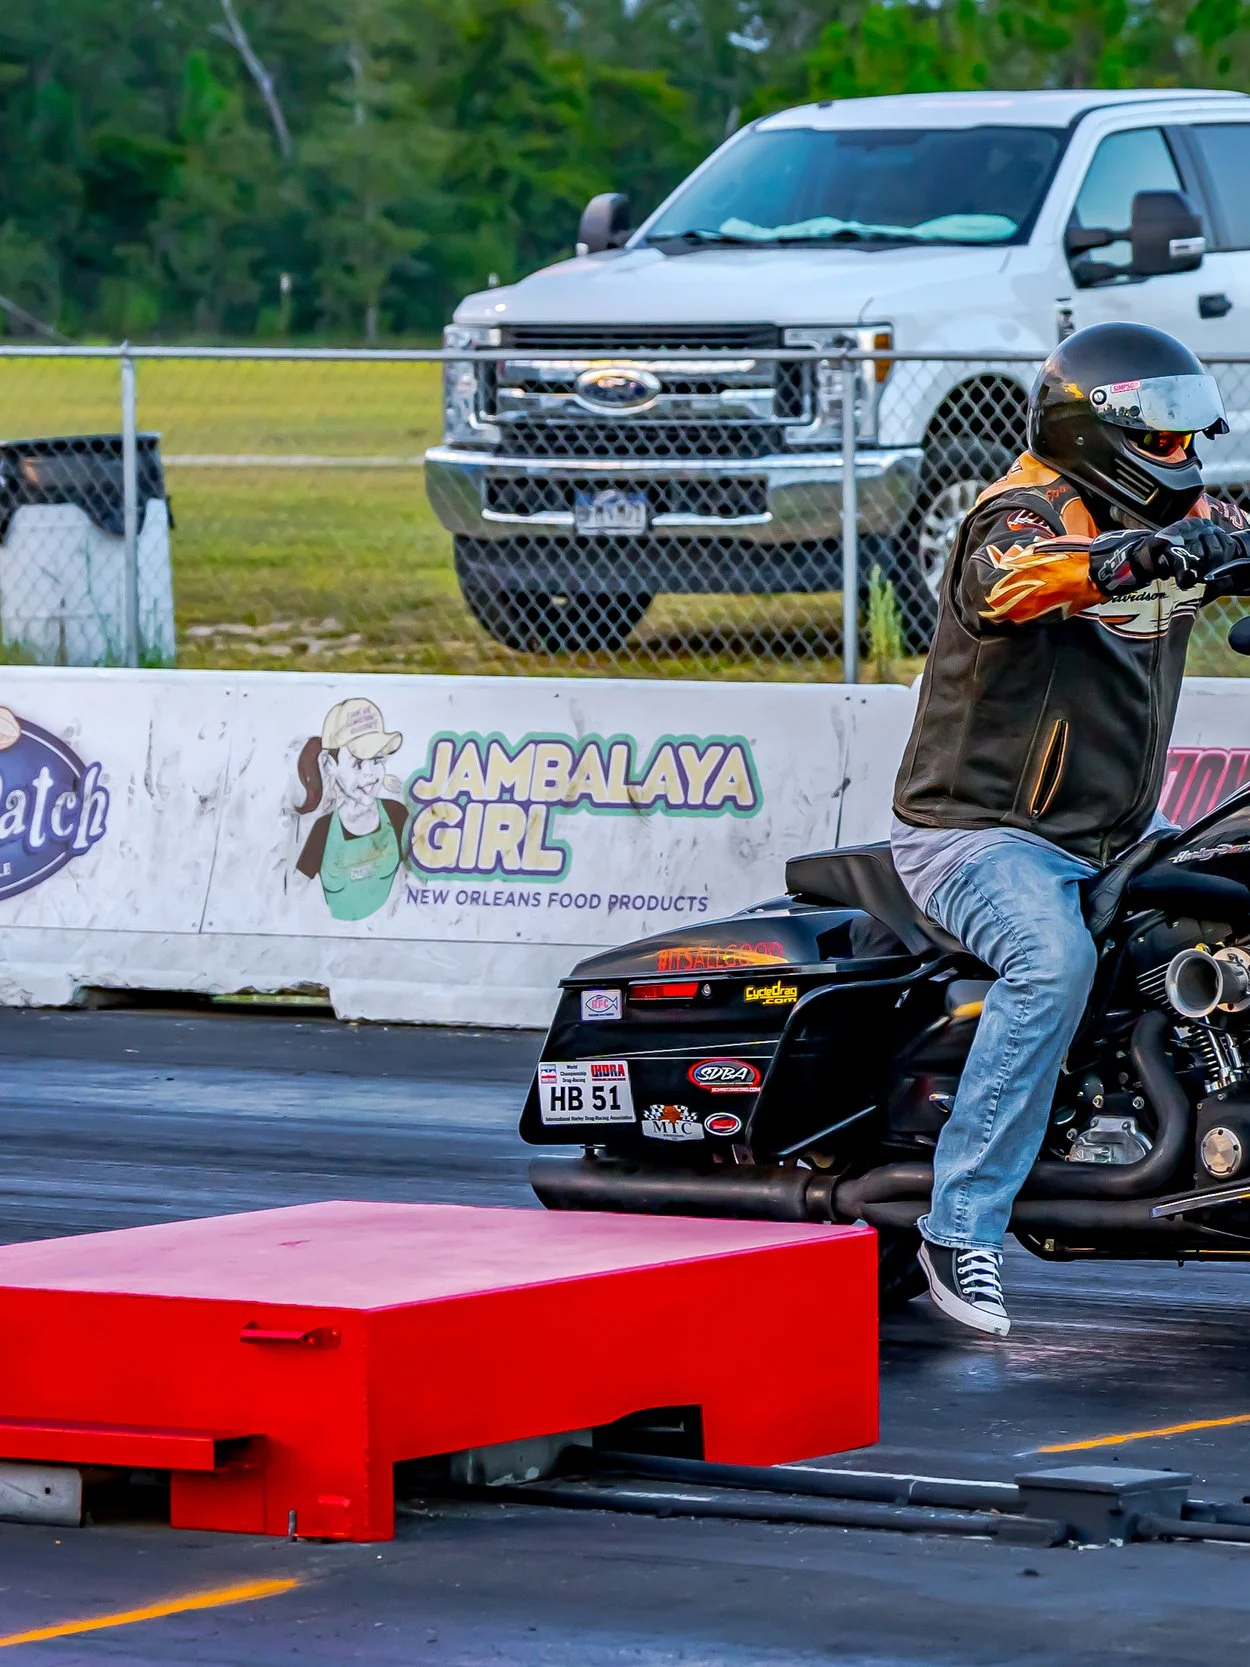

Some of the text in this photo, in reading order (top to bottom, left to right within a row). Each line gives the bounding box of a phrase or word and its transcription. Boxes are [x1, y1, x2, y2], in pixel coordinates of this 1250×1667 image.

[1111, 591, 1169, 603] avidson
[410, 740, 757, 807] JAMBALAYA
[0, 765, 106, 849] atch
[411, 801, 566, 873] GIRL
[406, 888, 709, 913] NEW ORLEANS FOOD PRODUCTS
[745, 980, 798, 1001] CycleDrag
[762, 997, 797, 1005] .com
[697, 1066, 749, 1080] SDBA
[550, 1085, 621, 1111] HB 51
[652, 1121, 693, 1135] MTC
